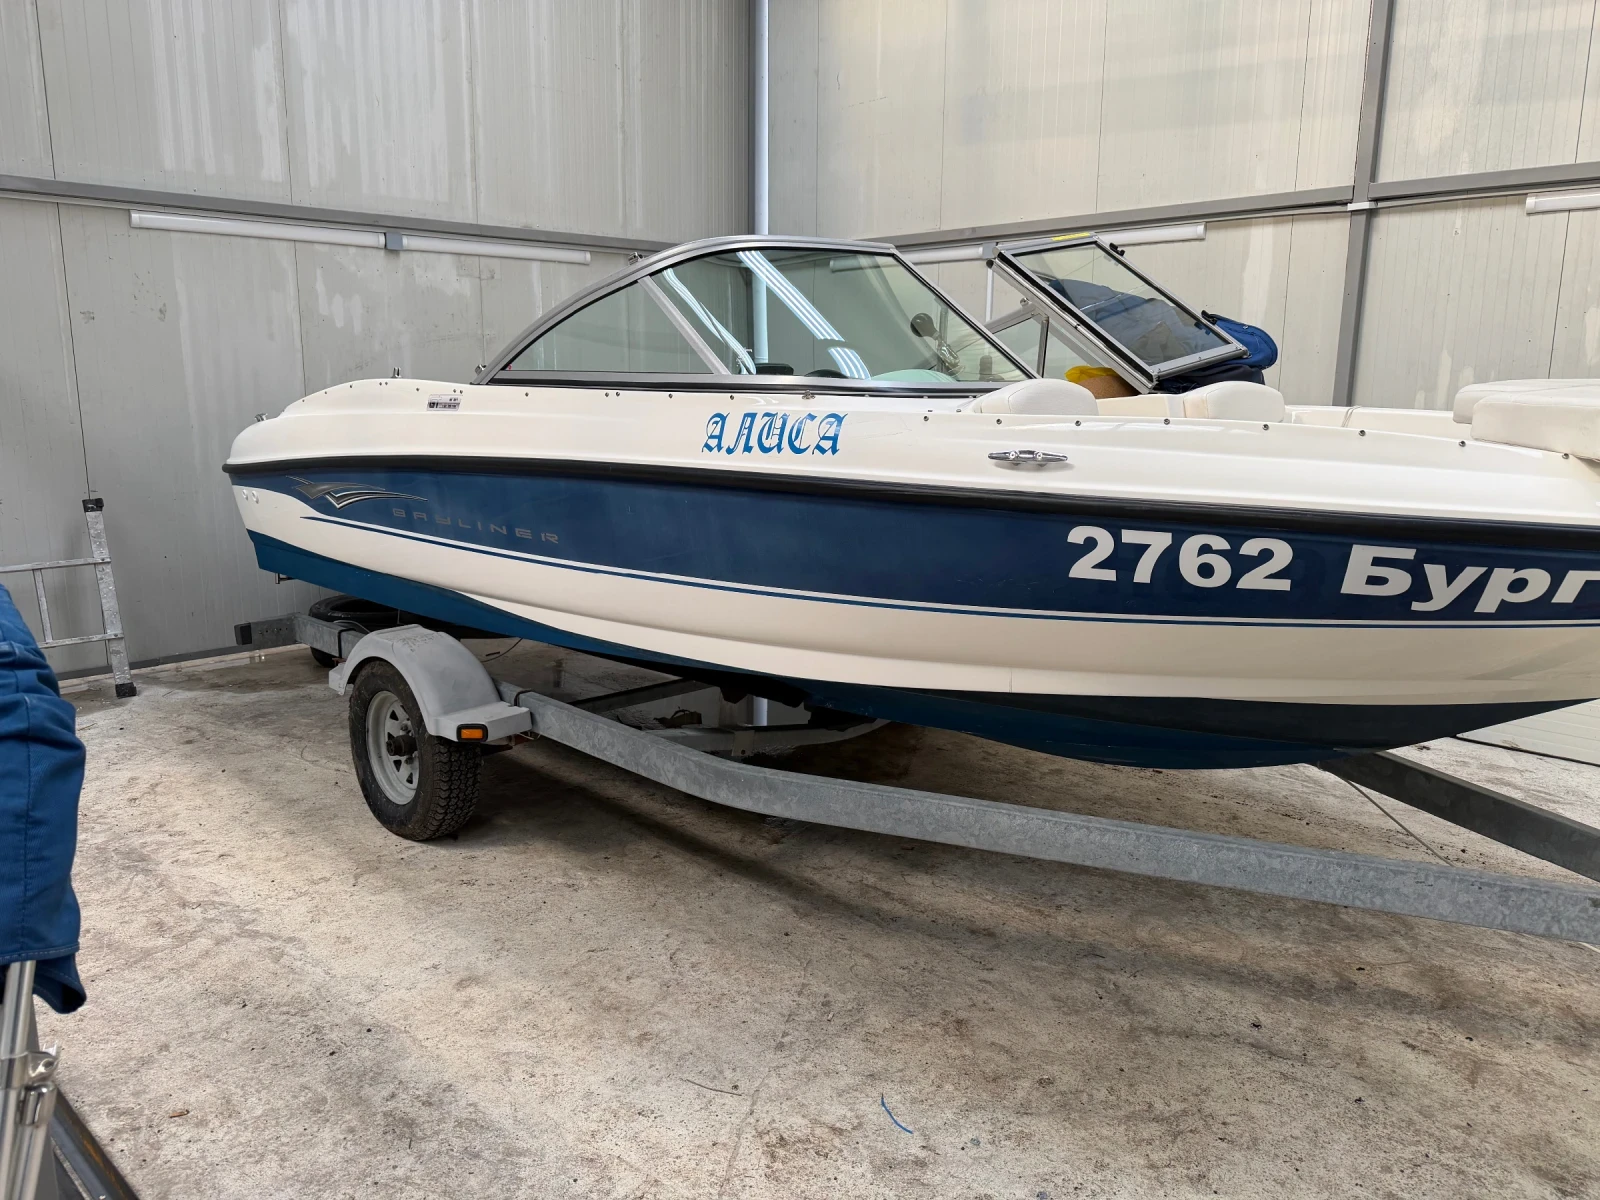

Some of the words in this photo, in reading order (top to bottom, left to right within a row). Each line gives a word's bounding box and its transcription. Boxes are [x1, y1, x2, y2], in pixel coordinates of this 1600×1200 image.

[701, 411, 849, 456] АЛИСА
[392, 507, 559, 544] BAYLINER
[1066, 525, 1294, 592] 2762
[1340, 544, 1600, 614] Бург
